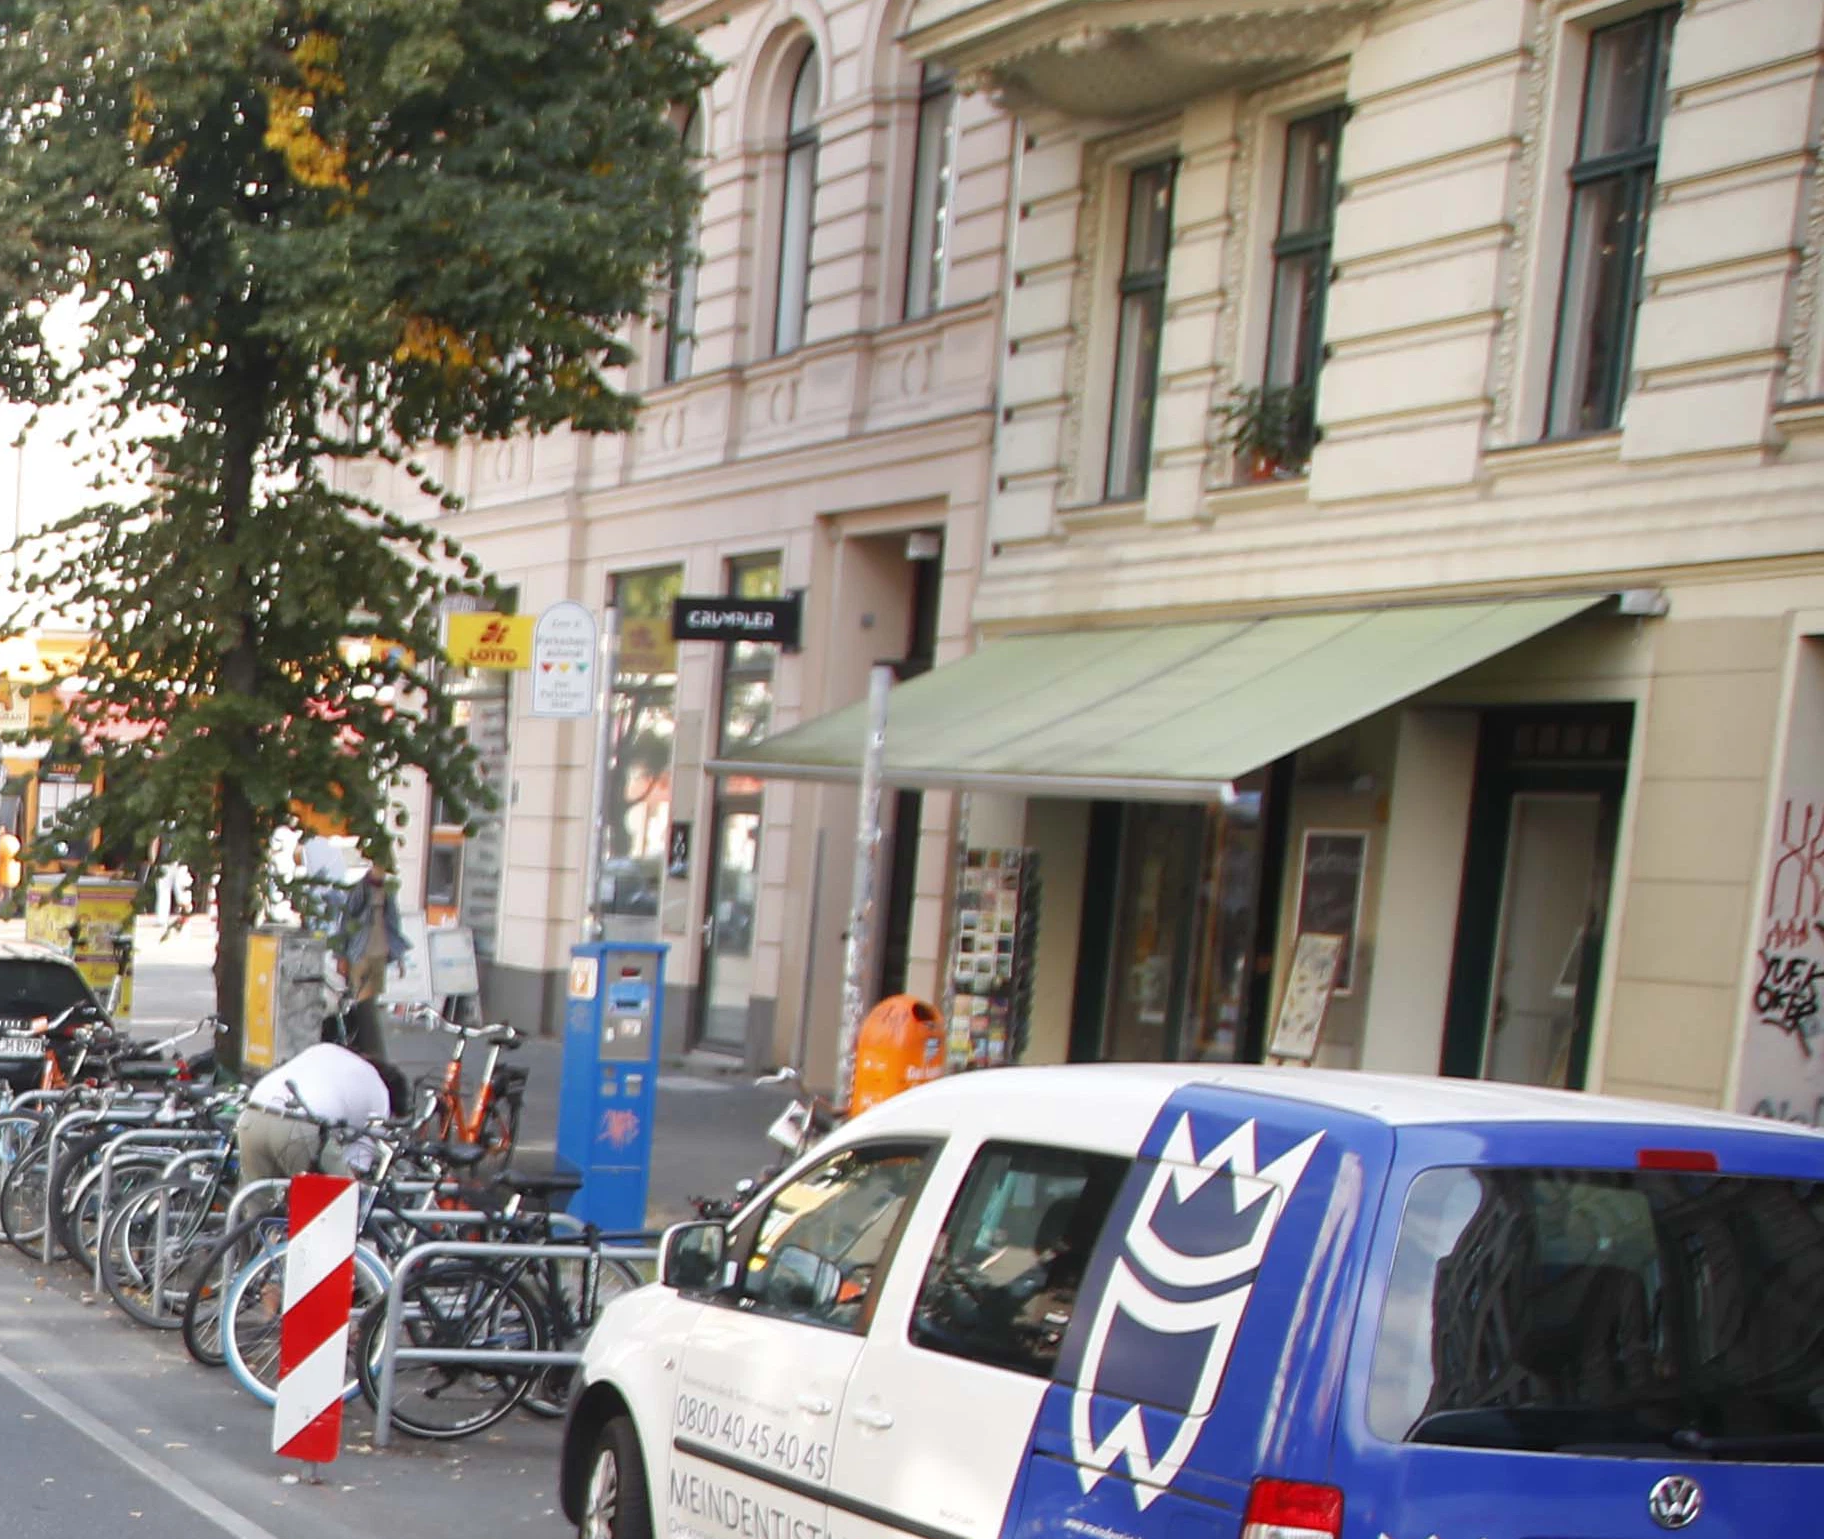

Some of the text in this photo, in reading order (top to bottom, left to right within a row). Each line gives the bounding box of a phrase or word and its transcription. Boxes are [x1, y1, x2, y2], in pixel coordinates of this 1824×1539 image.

[688, 610, 775, 628] CRUMPLER
[468, 648, 518, 663] LOTTO
[677, 1393, 719, 1438] 0800
[722, 1411, 745, 1449] 40
[748, 1421, 771, 1459] 45
[774, 1430, 800, 1470] 40
[803, 1442, 829, 1480] 45
